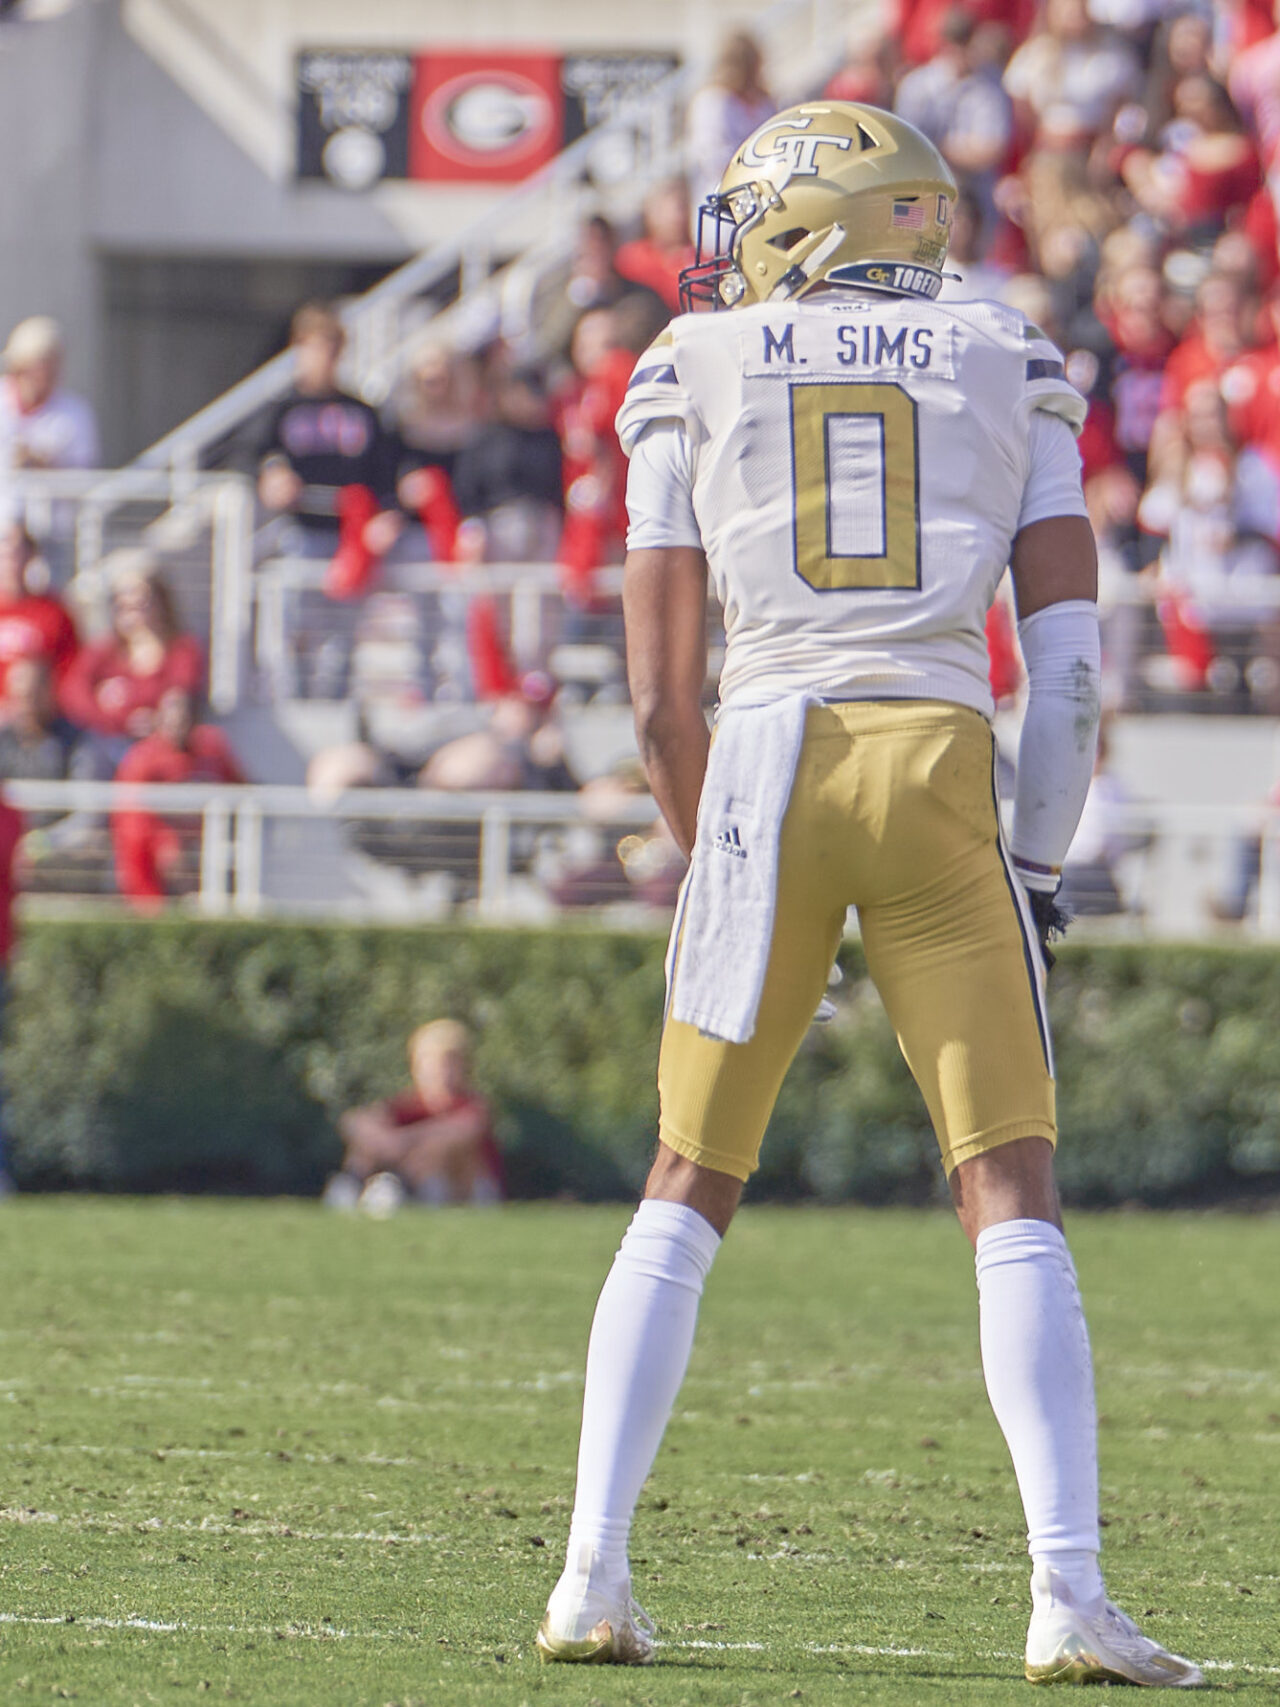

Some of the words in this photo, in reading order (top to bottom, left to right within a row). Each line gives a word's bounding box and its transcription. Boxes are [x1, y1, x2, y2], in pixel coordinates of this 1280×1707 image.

[741, 116, 853, 177] GT
[761, 323, 807, 364] M.
[836, 324, 934, 369] SIMS
[788, 381, 922, 593] 0
